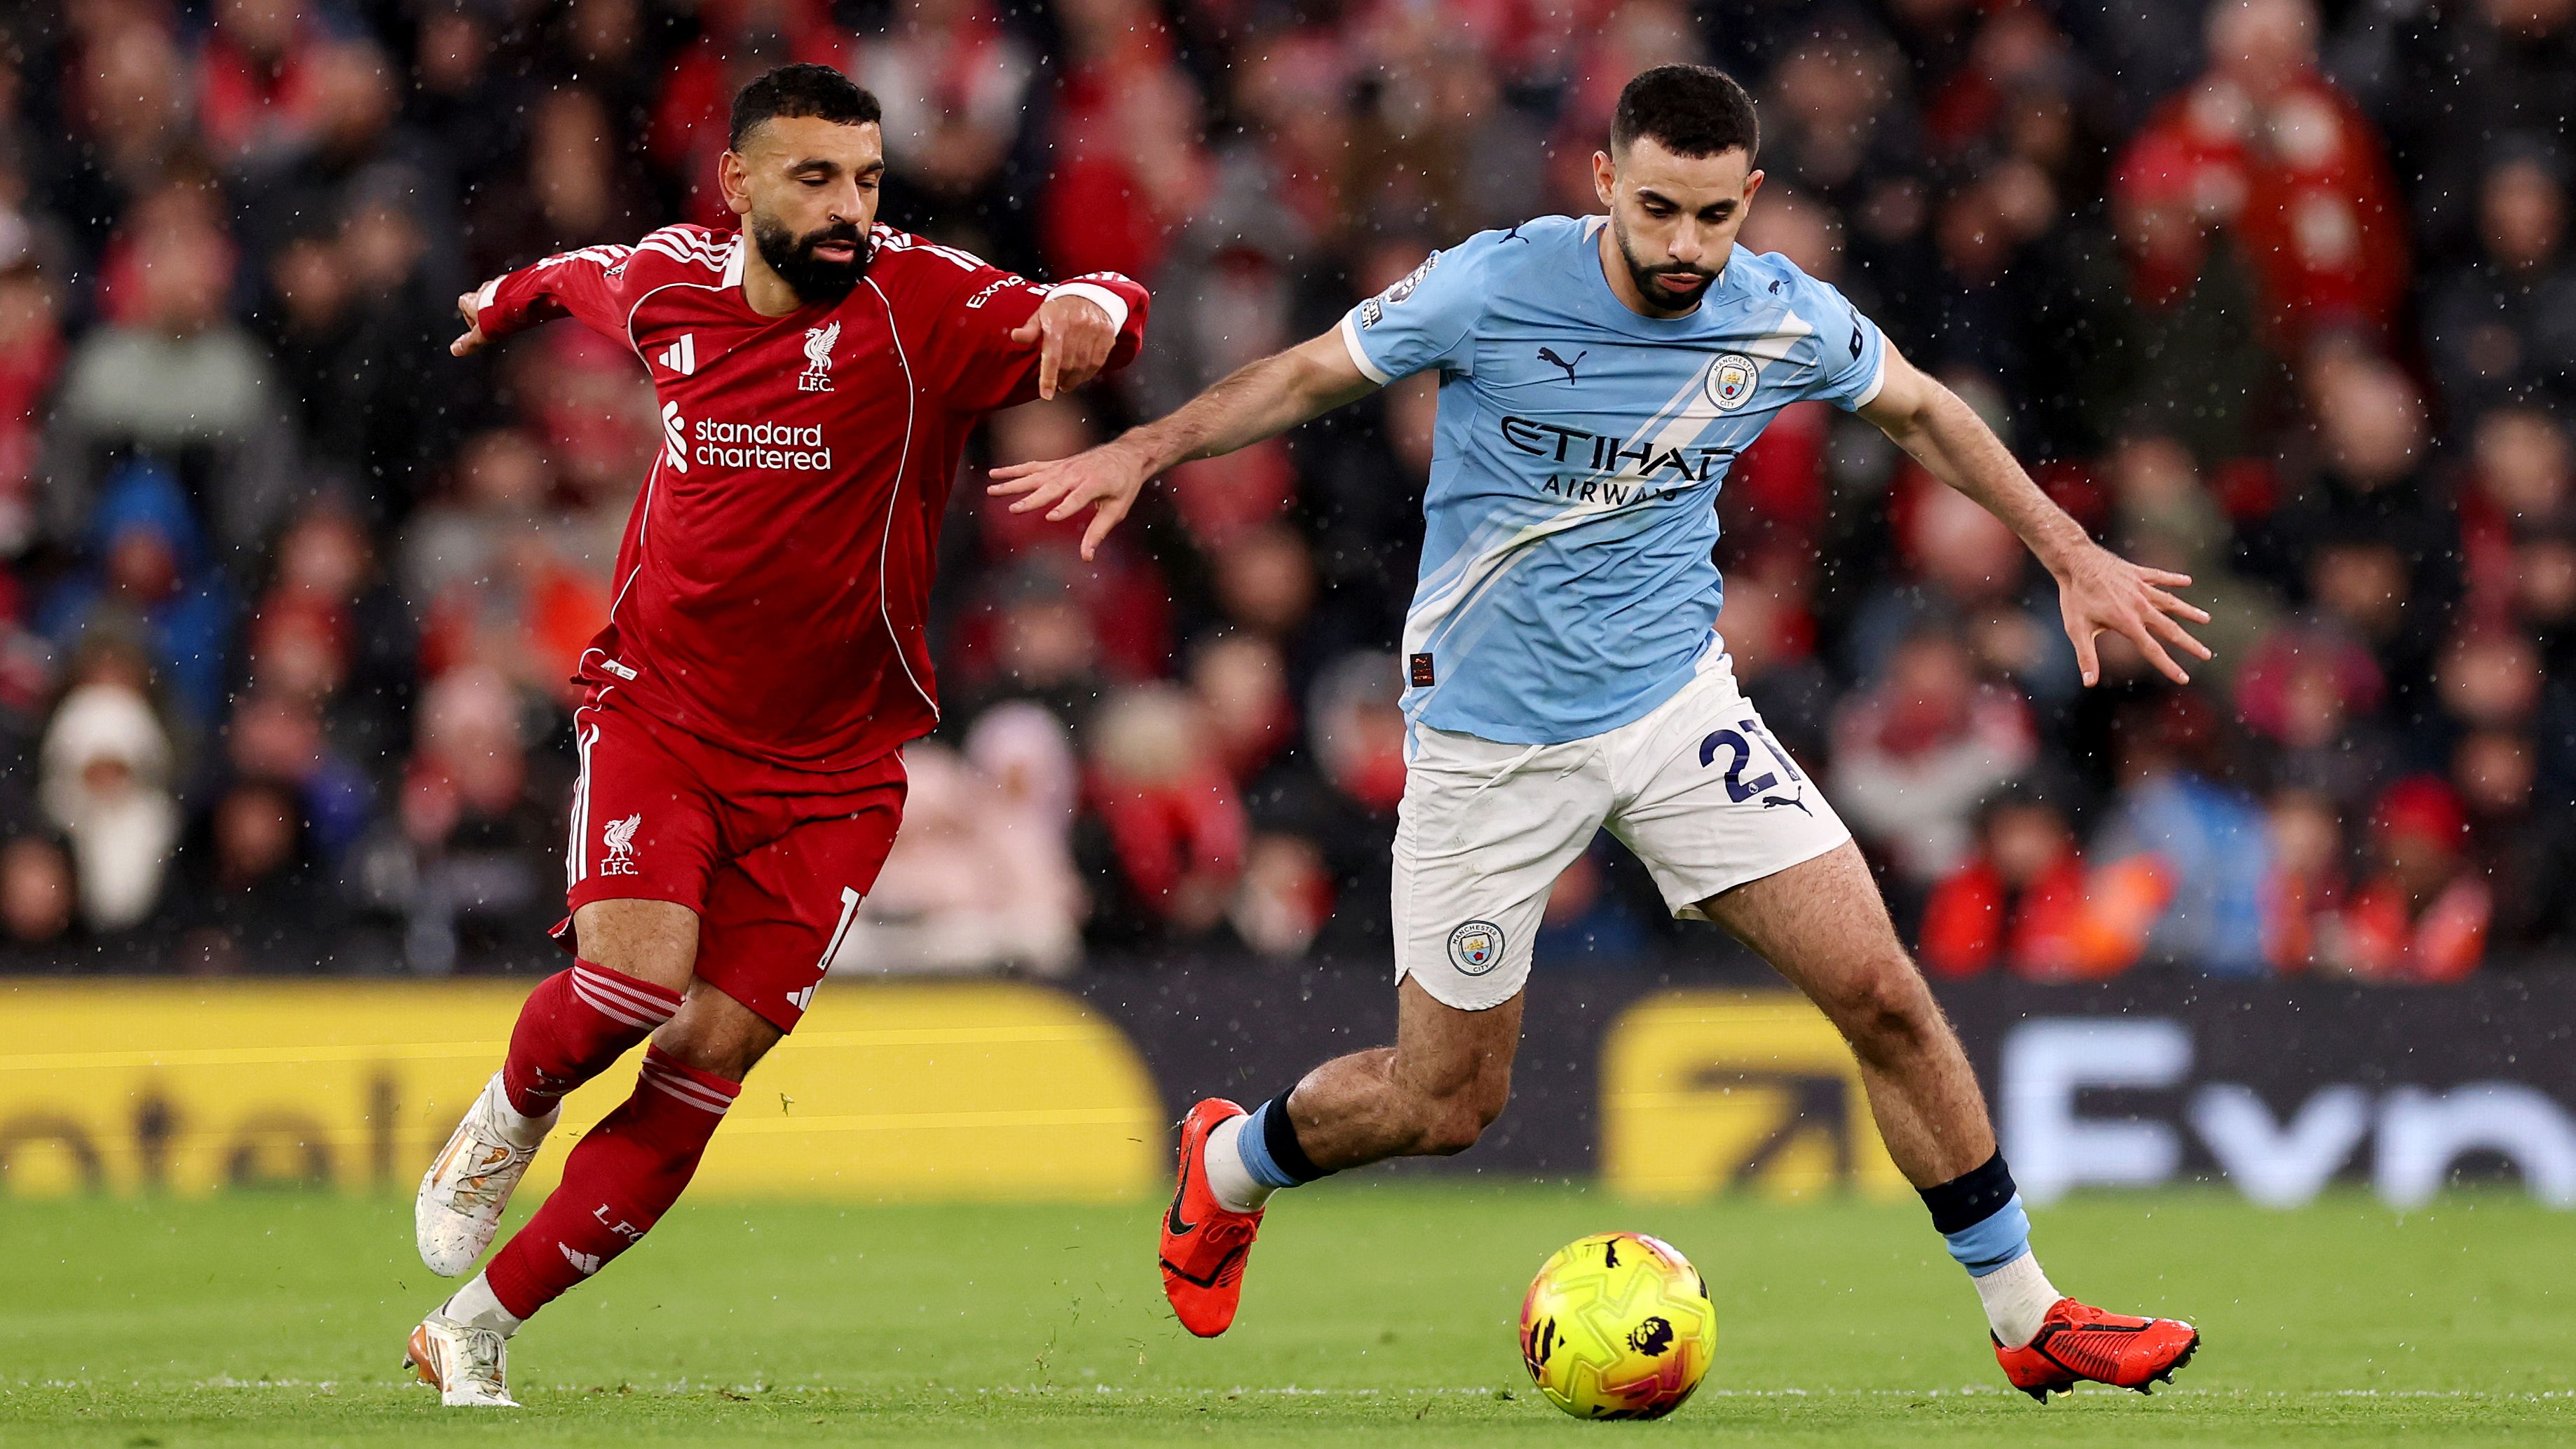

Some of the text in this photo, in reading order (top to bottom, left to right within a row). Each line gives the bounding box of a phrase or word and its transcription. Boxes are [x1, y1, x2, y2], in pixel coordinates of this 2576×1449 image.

[1714, 356, 1755, 378] MANCHESTER
[798, 376, 835, 392] L.F.C.
[695, 416, 822, 447] standard
[695, 442, 831, 470] chartered
[600, 862, 639, 876] L.F.C.
[1452, 925, 1497, 945] MANCHESTER
[1473, 963, 1490, 972] CITY
